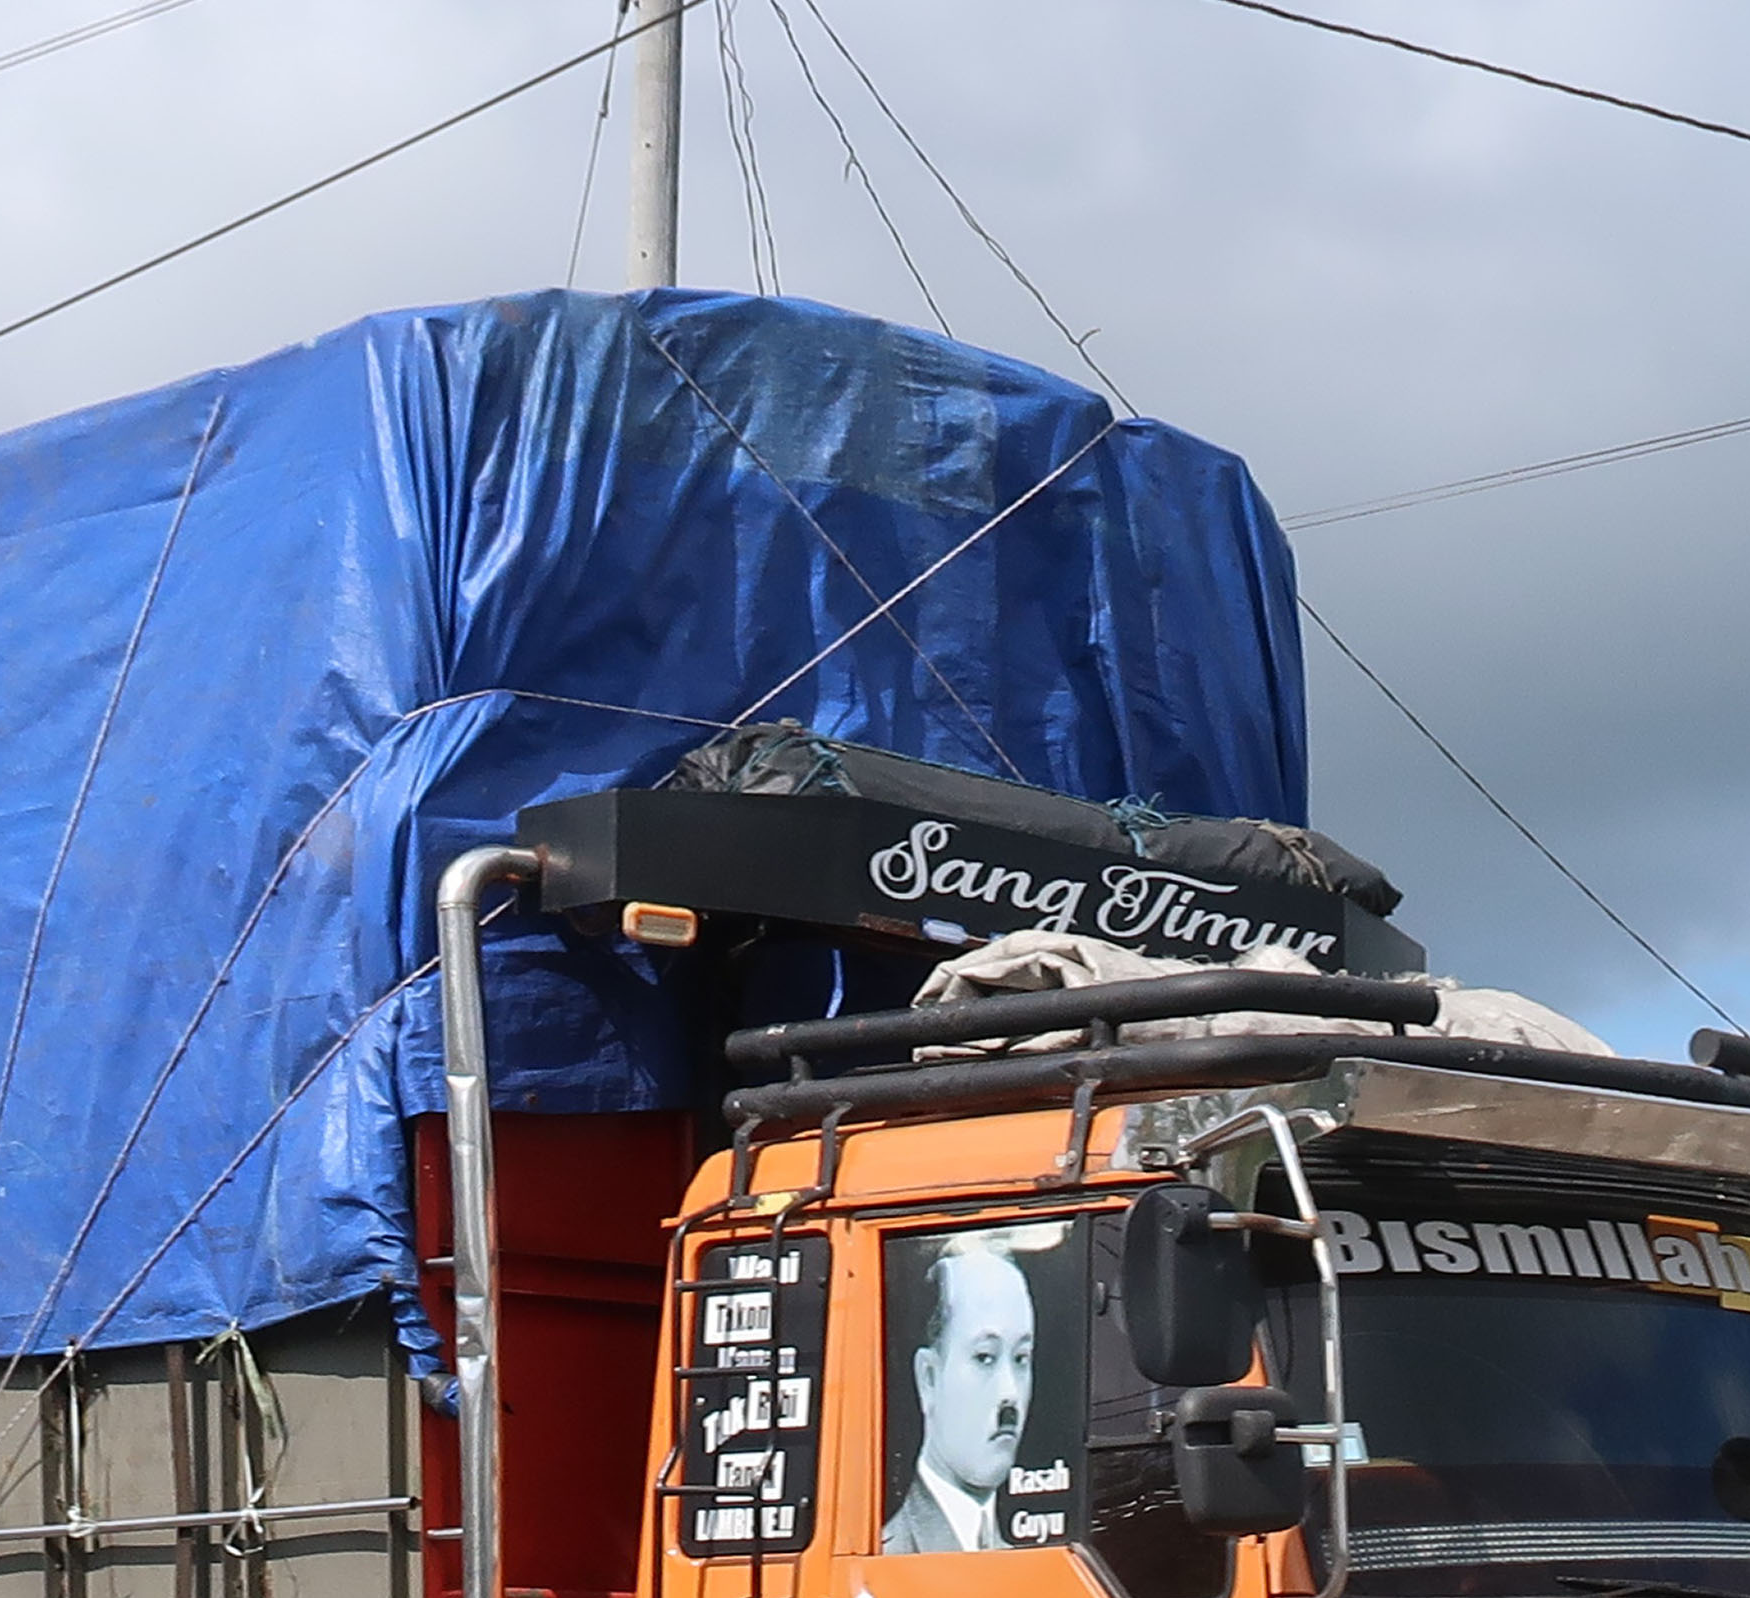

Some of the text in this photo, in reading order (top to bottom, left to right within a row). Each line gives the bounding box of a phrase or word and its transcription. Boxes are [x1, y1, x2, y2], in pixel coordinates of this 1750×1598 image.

[869, 820, 1337, 957] Sang Timur
[1009, 1459, 1069, 1494] Rasah
[1011, 1510, 1064, 1543] Guyu
